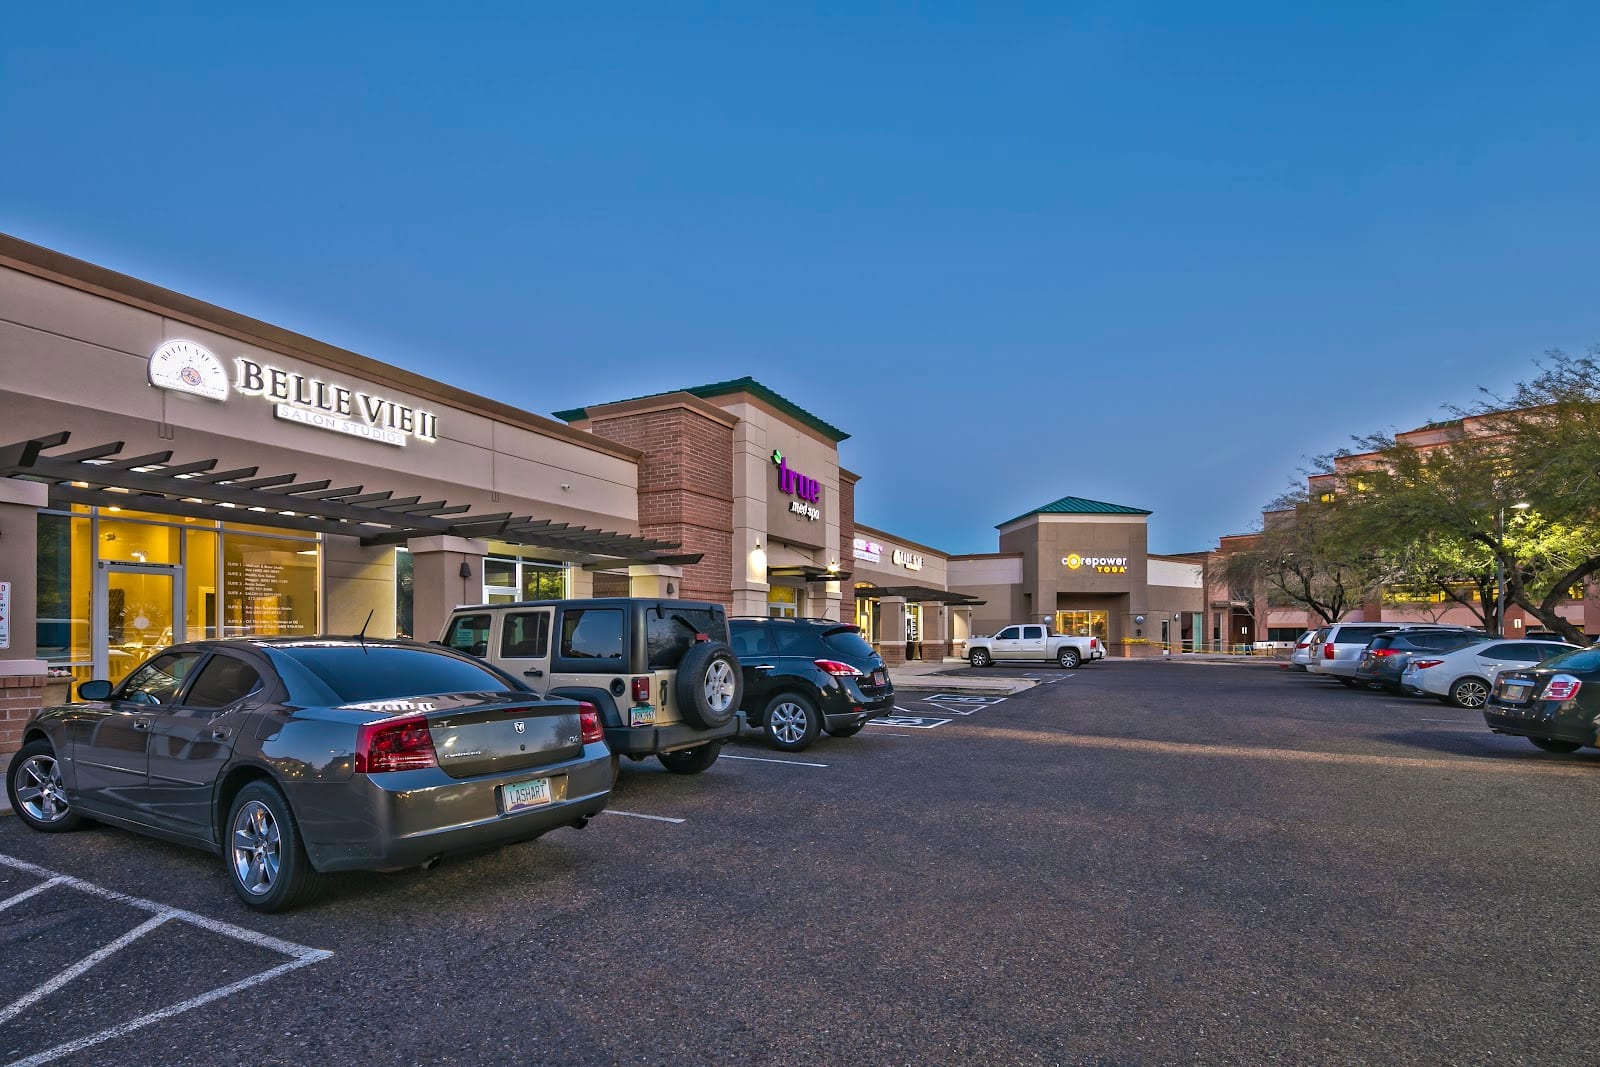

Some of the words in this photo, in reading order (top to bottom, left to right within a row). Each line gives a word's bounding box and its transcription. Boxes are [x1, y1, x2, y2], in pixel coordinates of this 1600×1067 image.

[240, 358, 352, 416] BELLE
[357, 392, 415, 433] VIE
[280, 405, 336, 429] SALON
[341, 421, 405, 446] STUDIOS
[777, 456, 820, 504] true
[791, 501, 808, 516] med
[807, 506, 820, 521] spa
[1061, 553, 1128, 569] corepower
[1096, 565, 1125, 573] YOGA
[509, 784, 546, 805] LASHART
